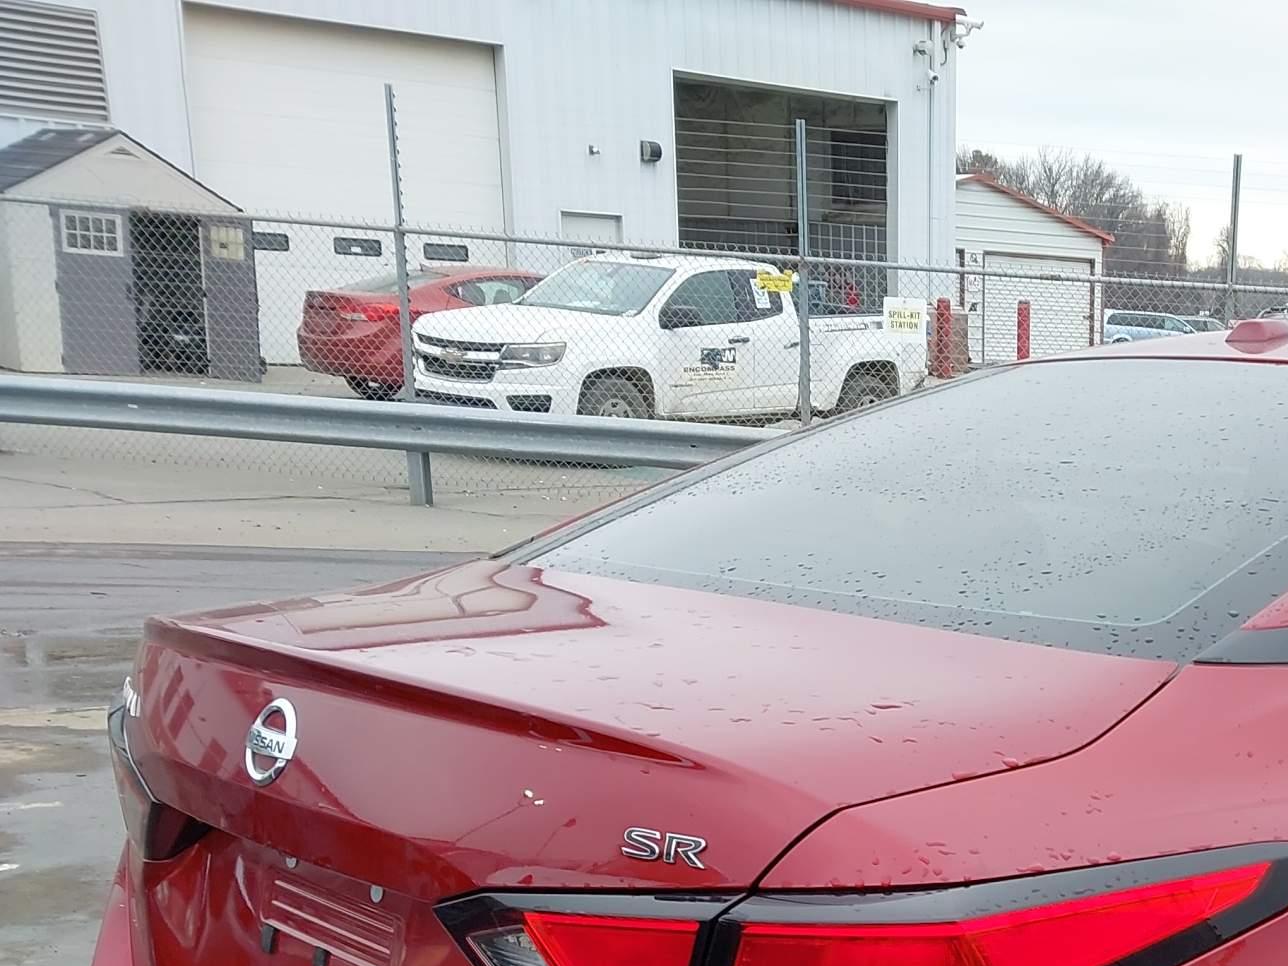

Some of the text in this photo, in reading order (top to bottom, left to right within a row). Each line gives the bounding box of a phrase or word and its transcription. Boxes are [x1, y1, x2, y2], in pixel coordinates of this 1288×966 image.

[888, 310, 921, 320] SPILL-KIT
[890, 320, 919, 330] STATION
[620, 826, 707, 870] SR
